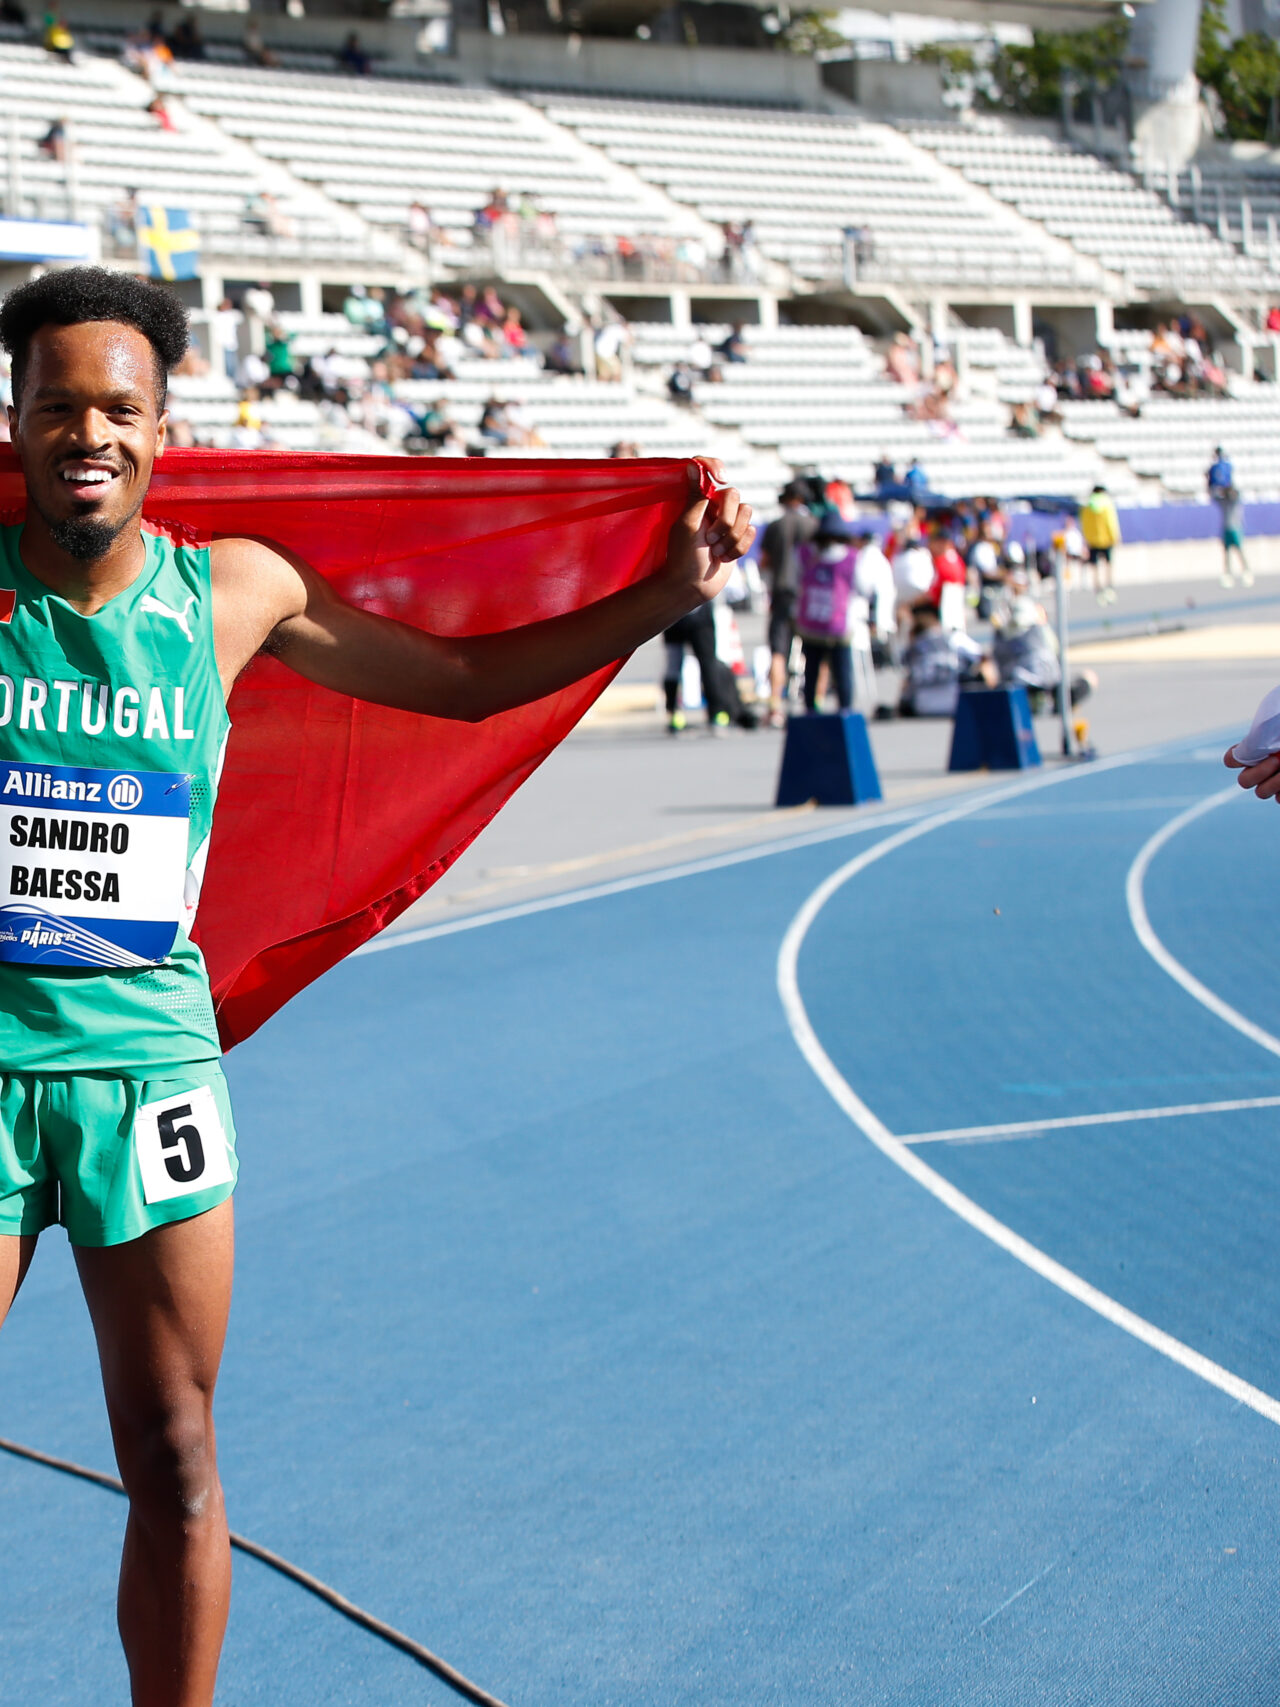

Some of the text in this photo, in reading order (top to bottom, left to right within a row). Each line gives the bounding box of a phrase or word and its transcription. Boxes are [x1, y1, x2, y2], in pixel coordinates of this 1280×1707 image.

[3, 770, 102, 802] Allianz
[9, 815, 130, 855] SANDRO
[10, 865, 120, 903] BAESSA
[157, 1104, 205, 1183] 5
